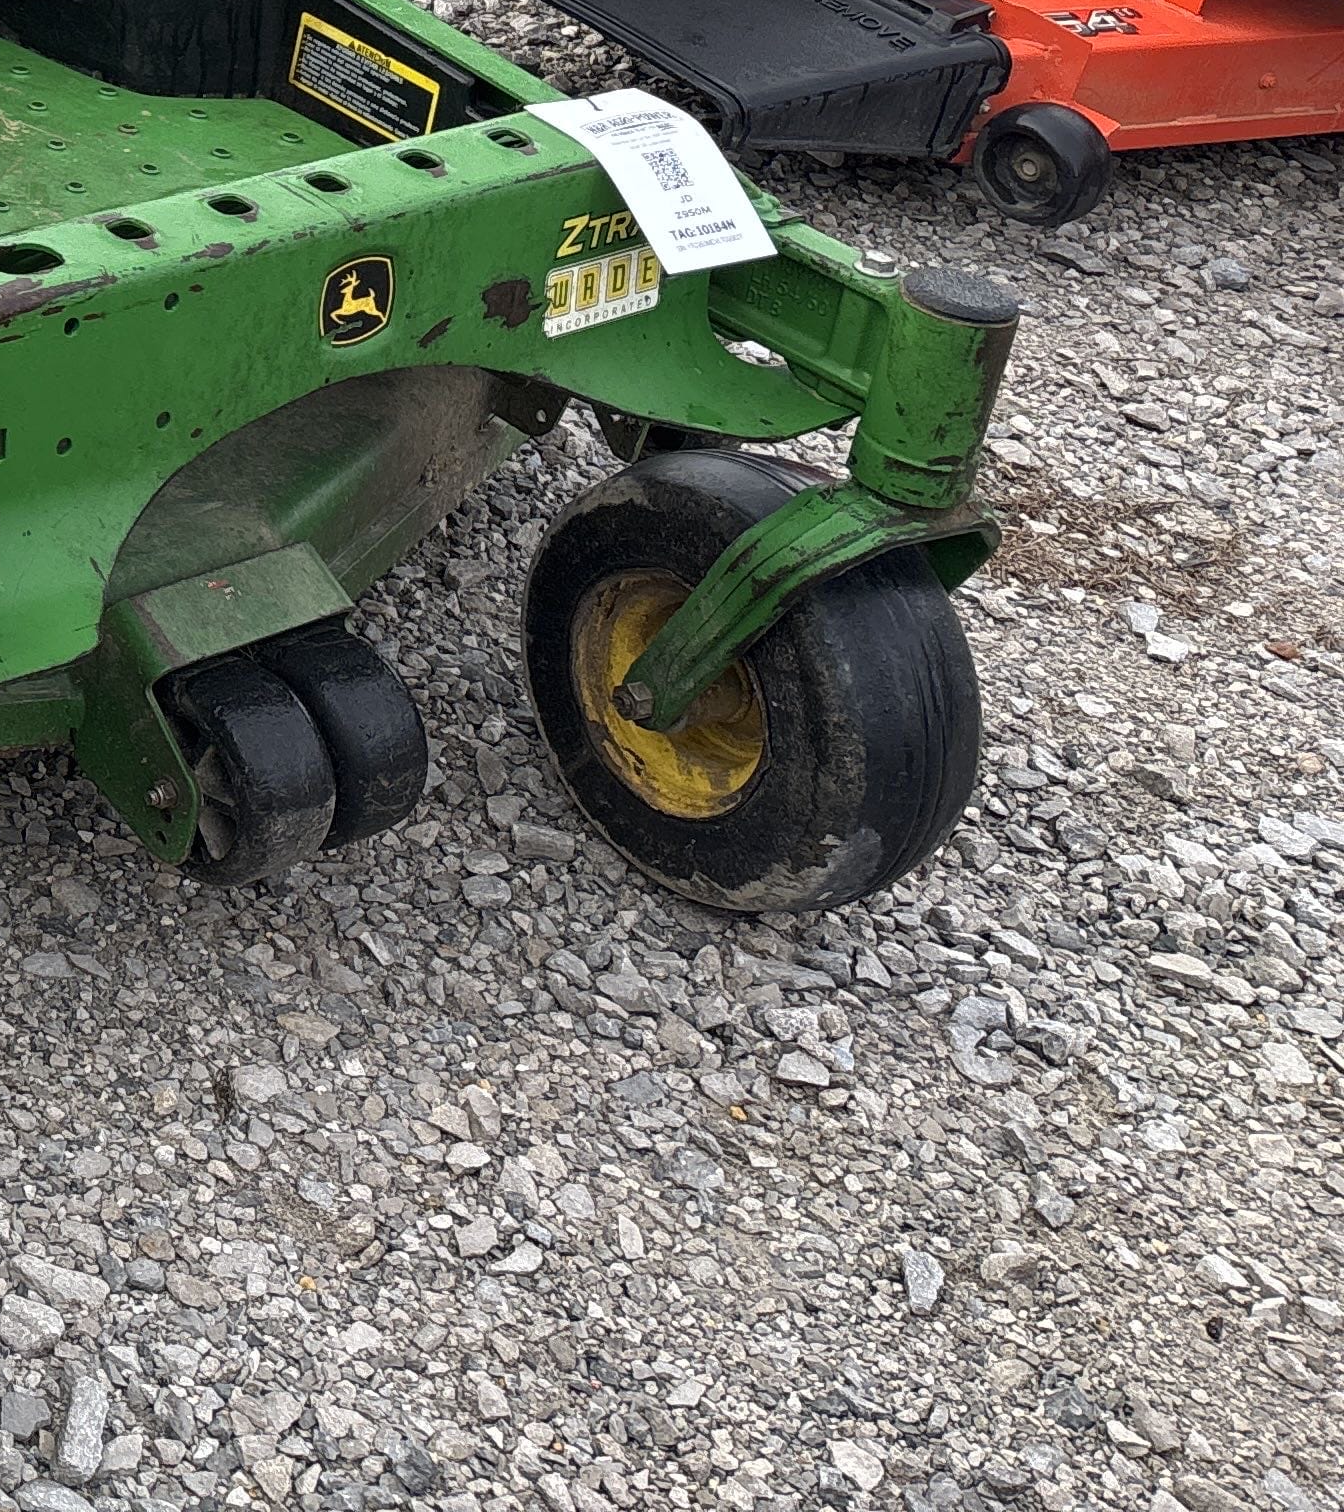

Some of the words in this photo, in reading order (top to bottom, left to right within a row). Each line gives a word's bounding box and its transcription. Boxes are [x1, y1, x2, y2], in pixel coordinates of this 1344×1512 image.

[680, 194, 693, 204] JD
[674, 206, 713, 220] Z950M
[668, 218, 737, 241] TAG:10184N
[551, 255, 657, 310] WADE
[548, 294, 653, 336] INCORPORATED
